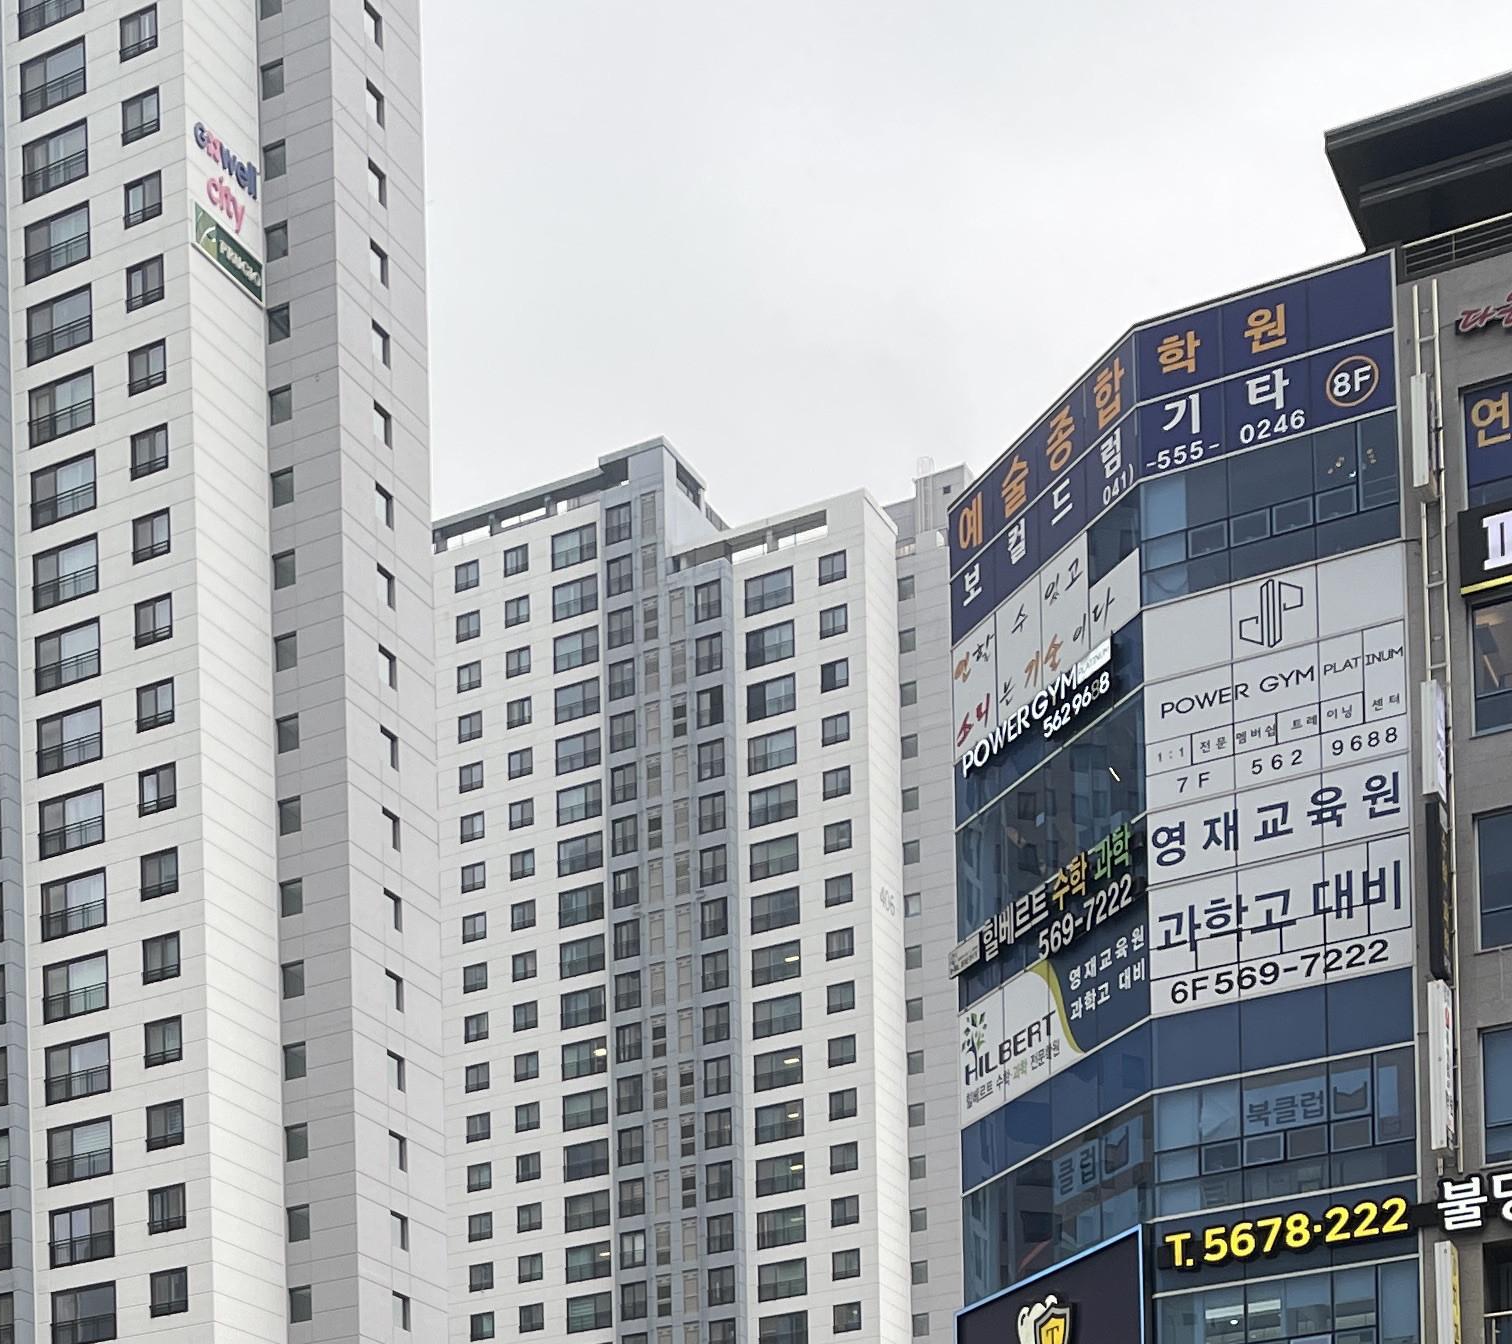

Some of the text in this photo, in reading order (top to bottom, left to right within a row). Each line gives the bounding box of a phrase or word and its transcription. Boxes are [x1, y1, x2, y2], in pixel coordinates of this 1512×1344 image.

[206, 176, 245, 235] city
[1333, 365, 1371, 397] 8F
[1161, 646, 1403, 719] POWER GYM PLATINUM
[963, 709, 1030, 778] POWER
[1032, 663, 1077, 717] GYM
[1251, 750, 1303, 775] 562
[1332, 727, 1398, 756] 9688
[1152, 771, 1400, 866] 영재교육원
[982, 883, 1048, 962] 힐베르트
[1052, 851, 1088, 910] 수학
[1094, 822, 1132, 880] 과학
[1038, 873, 1132, 960] 569-7222
[1157, 888, 1296, 951] 과학고
[1313, 860, 1400, 920] 대비
[1068, 925, 1145, 990] 영재교육원
[1070, 958, 1146, 1020] 과학고 대비
[965, 1011, 1056, 1086] HILBERT
[1246, 1089, 1324, 1127] 북클럽
